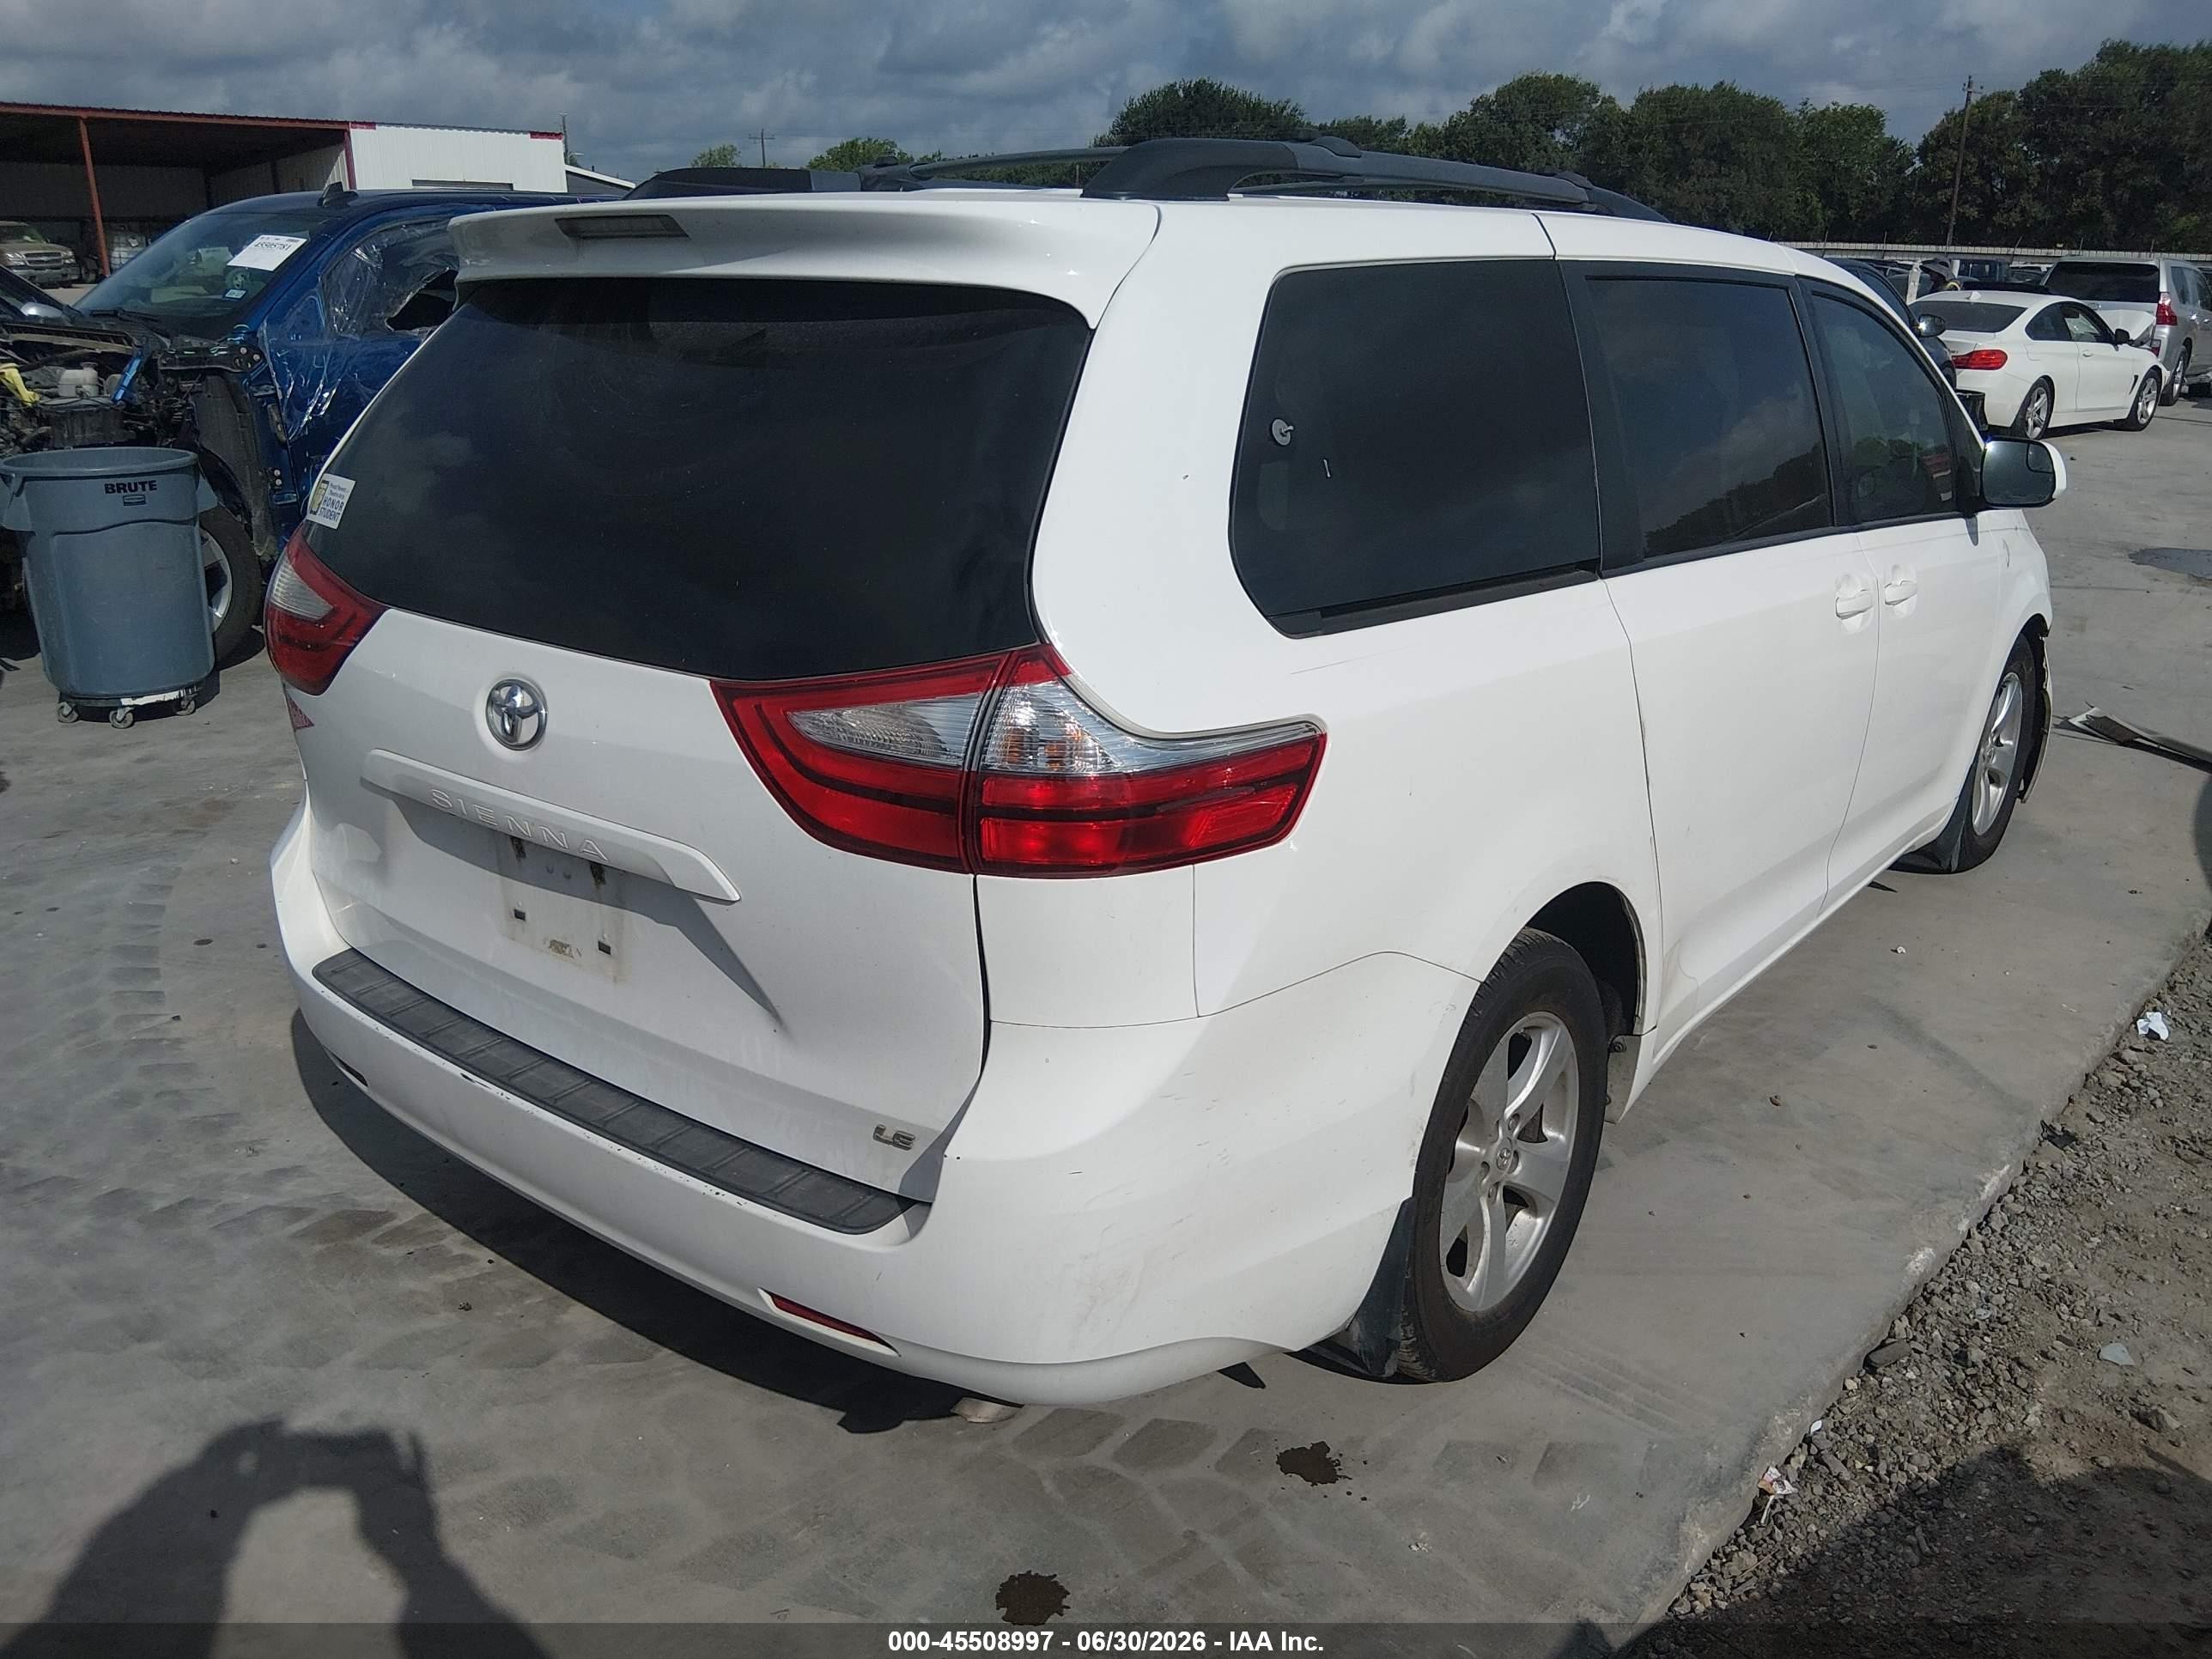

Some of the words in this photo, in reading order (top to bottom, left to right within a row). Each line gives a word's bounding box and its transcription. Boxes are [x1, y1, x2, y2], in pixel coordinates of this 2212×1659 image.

[104, 480, 157, 494] BRUTE
[322, 495, 344, 512] HONOR
[319, 507, 341, 522] STUDENT
[431, 788, 609, 861] SIENNA
[872, 1124, 915, 1151] LE
